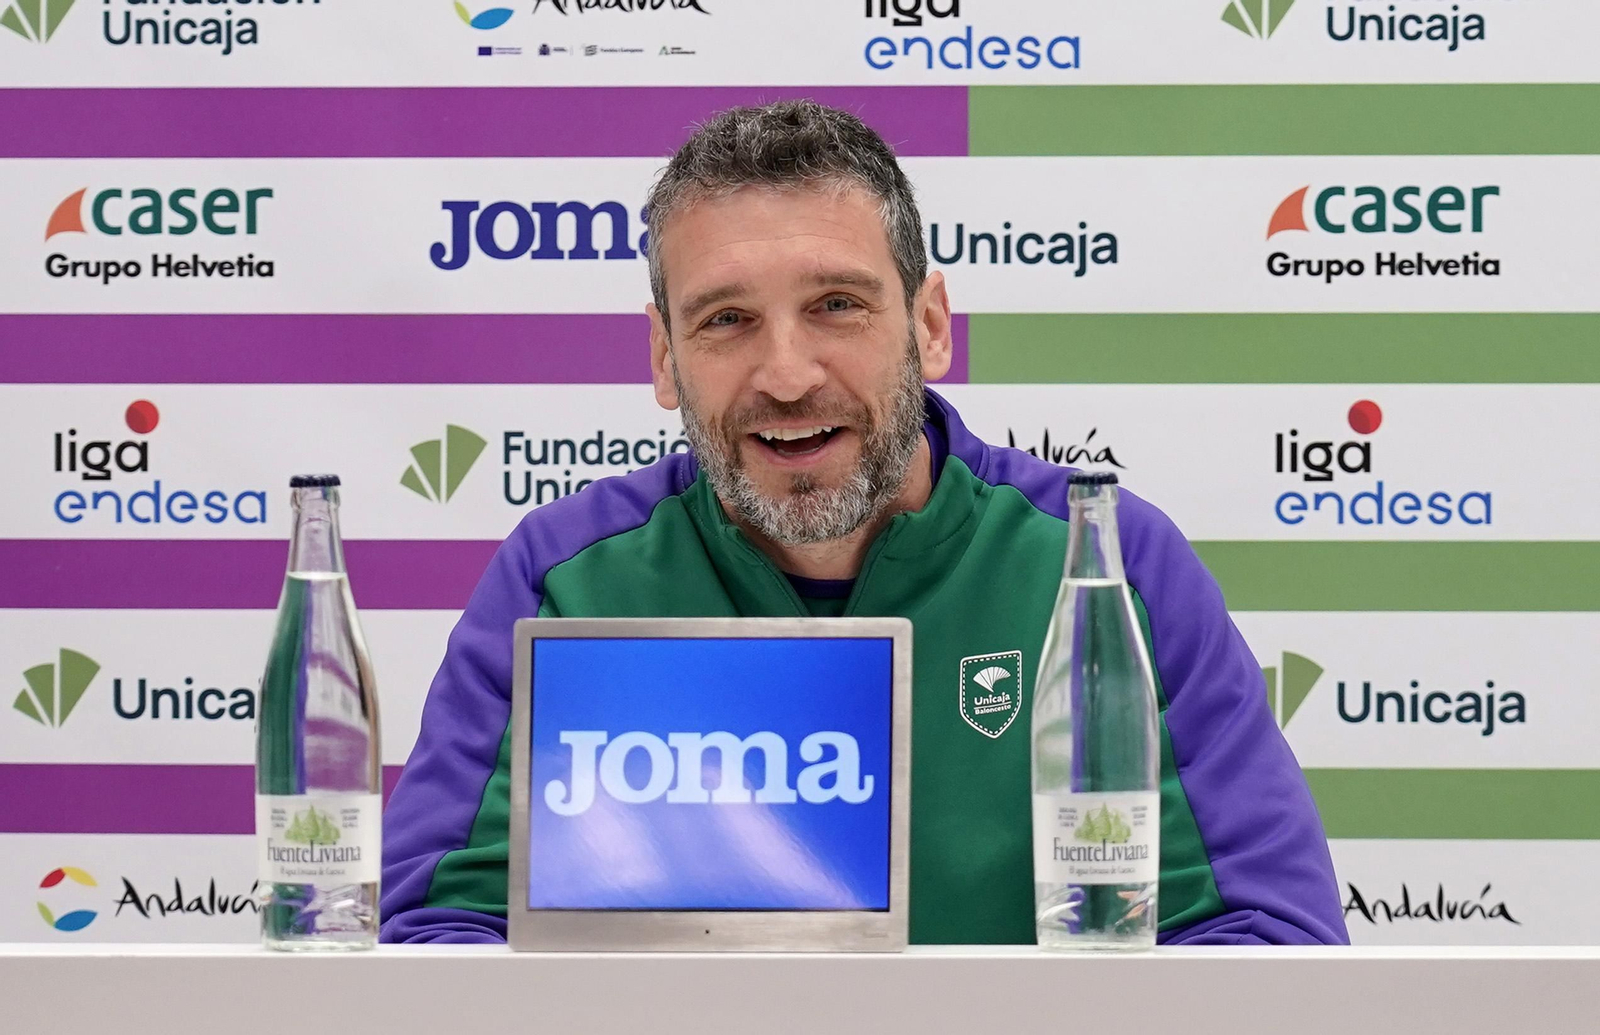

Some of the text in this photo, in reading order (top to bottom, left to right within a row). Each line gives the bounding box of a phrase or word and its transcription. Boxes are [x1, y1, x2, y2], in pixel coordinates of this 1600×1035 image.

[103, 9, 258, 55] Unicaja
[865, 26, 1079, 70] endesa
[1327, 5, 1485, 51] Unicaja
[92, 188, 273, 235] caser
[1314, 185, 1500, 234] caser
[430, 200, 649, 270] Jom
[930, 222, 1118, 277] Unicaja
[45, 253, 274, 285] Grupo Helvetia
[1266, 251, 1500, 283] Grupo Helvetia
[55, 429, 148, 480] liga
[503, 430, 692, 465] Fundaci
[1275, 429, 1371, 481] liga
[54, 481, 266, 523] endesa
[1275, 481, 1491, 525] endesa
[113, 677, 257, 720] Unica
[974, 691, 1011, 706] Unicaja
[1337, 680, 1526, 736] Unicaja
[543, 730, 875, 817] Joma
[267, 838, 362, 863] FuenteLiviana
[1053, 837, 1150, 862] FuenteLiviana
[114, 876, 261, 918] Andalucí
[1343, 882, 1521, 926] Andalucía
